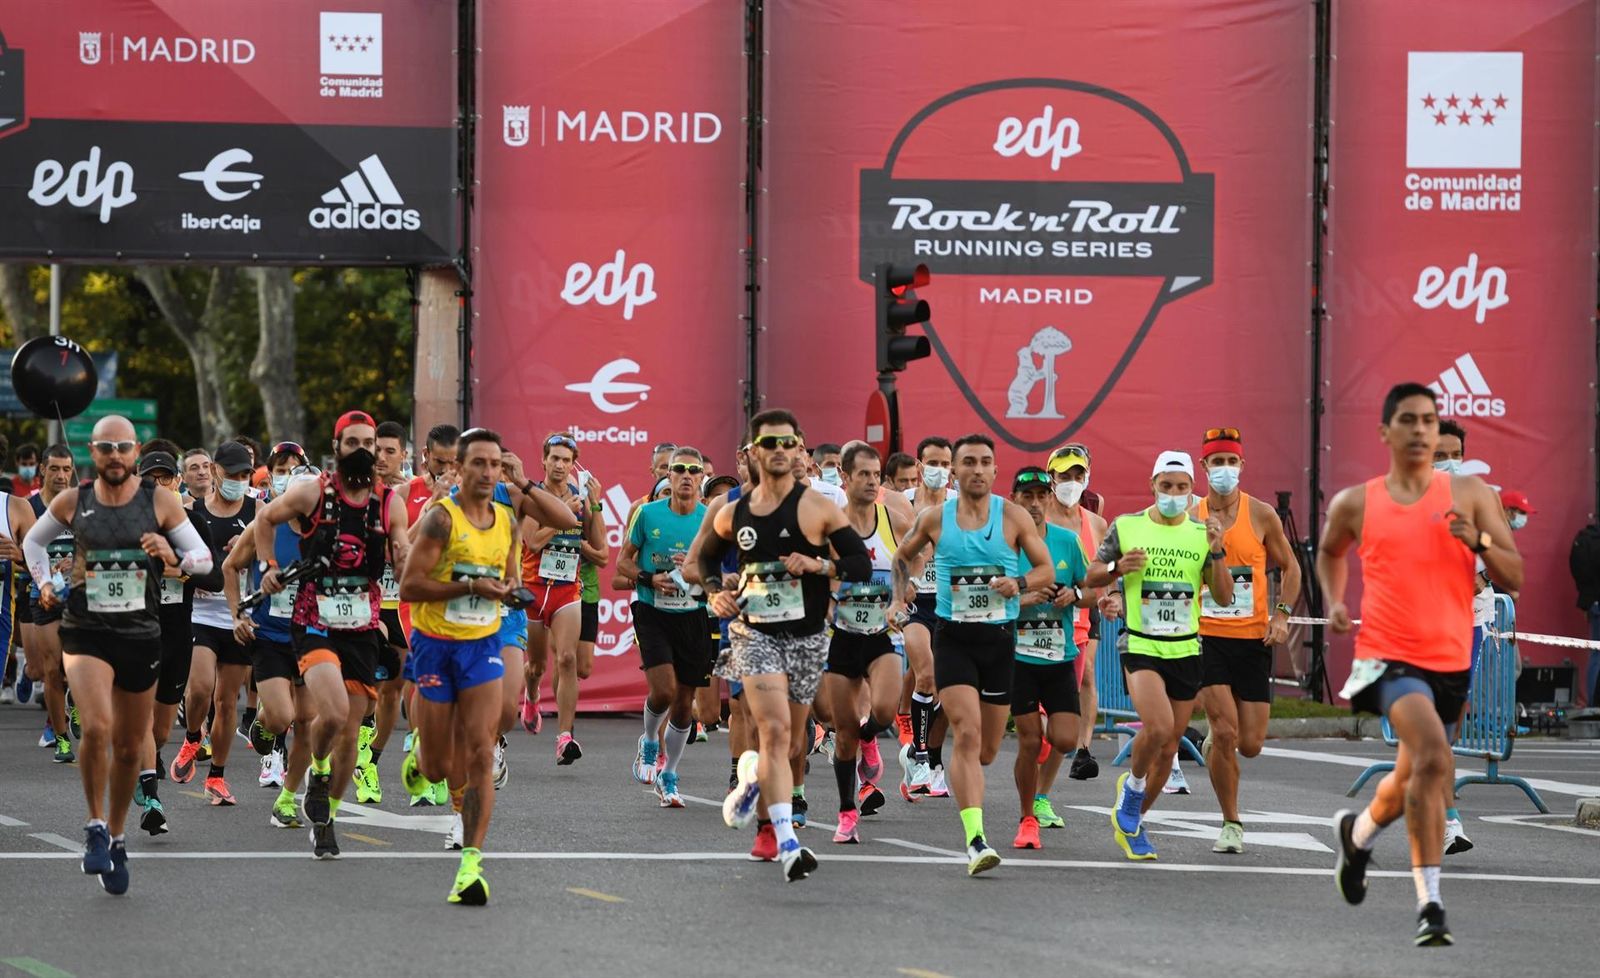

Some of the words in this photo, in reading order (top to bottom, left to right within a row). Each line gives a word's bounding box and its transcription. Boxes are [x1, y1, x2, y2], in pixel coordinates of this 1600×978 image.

[124, 37, 256, 64] MADRID
[320, 77, 383, 86] Comunidad
[320, 87, 336, 96] de
[339, 88, 383, 97] Madrid
[558, 110, 722, 143] MADRID
[993, 104, 1082, 171] edp
[28, 146, 137, 223] edp
[1405, 173, 1521, 190] Comunidad
[1405, 192, 1433, 210] de
[1441, 192, 1521, 210] Madrid
[182, 213, 261, 233] iberCaja
[309, 202, 421, 230] adidas
[914, 239, 1044, 257] RUNNING
[1052, 241, 1153, 258] SERIES
[560, 249, 657, 320] edp
[1413, 252, 1510, 324] edp
[979, 287, 1093, 304] MADRID
[1435, 393, 1506, 416] didas
[1140, 545, 1201, 562] MINANDO
[1152, 556, 1177, 567] CON
[555, 559, 566, 571] 80
[1144, 567, 1184, 579] AITANA
[925, 570, 937, 582] 68
[108, 582, 124, 598] 95
[766, 593, 781, 608] 35
[968, 594, 990, 609] 389
[335, 603, 354, 617] 197
[855, 610, 869, 624] 82
[1157, 609, 1177, 623] 101
